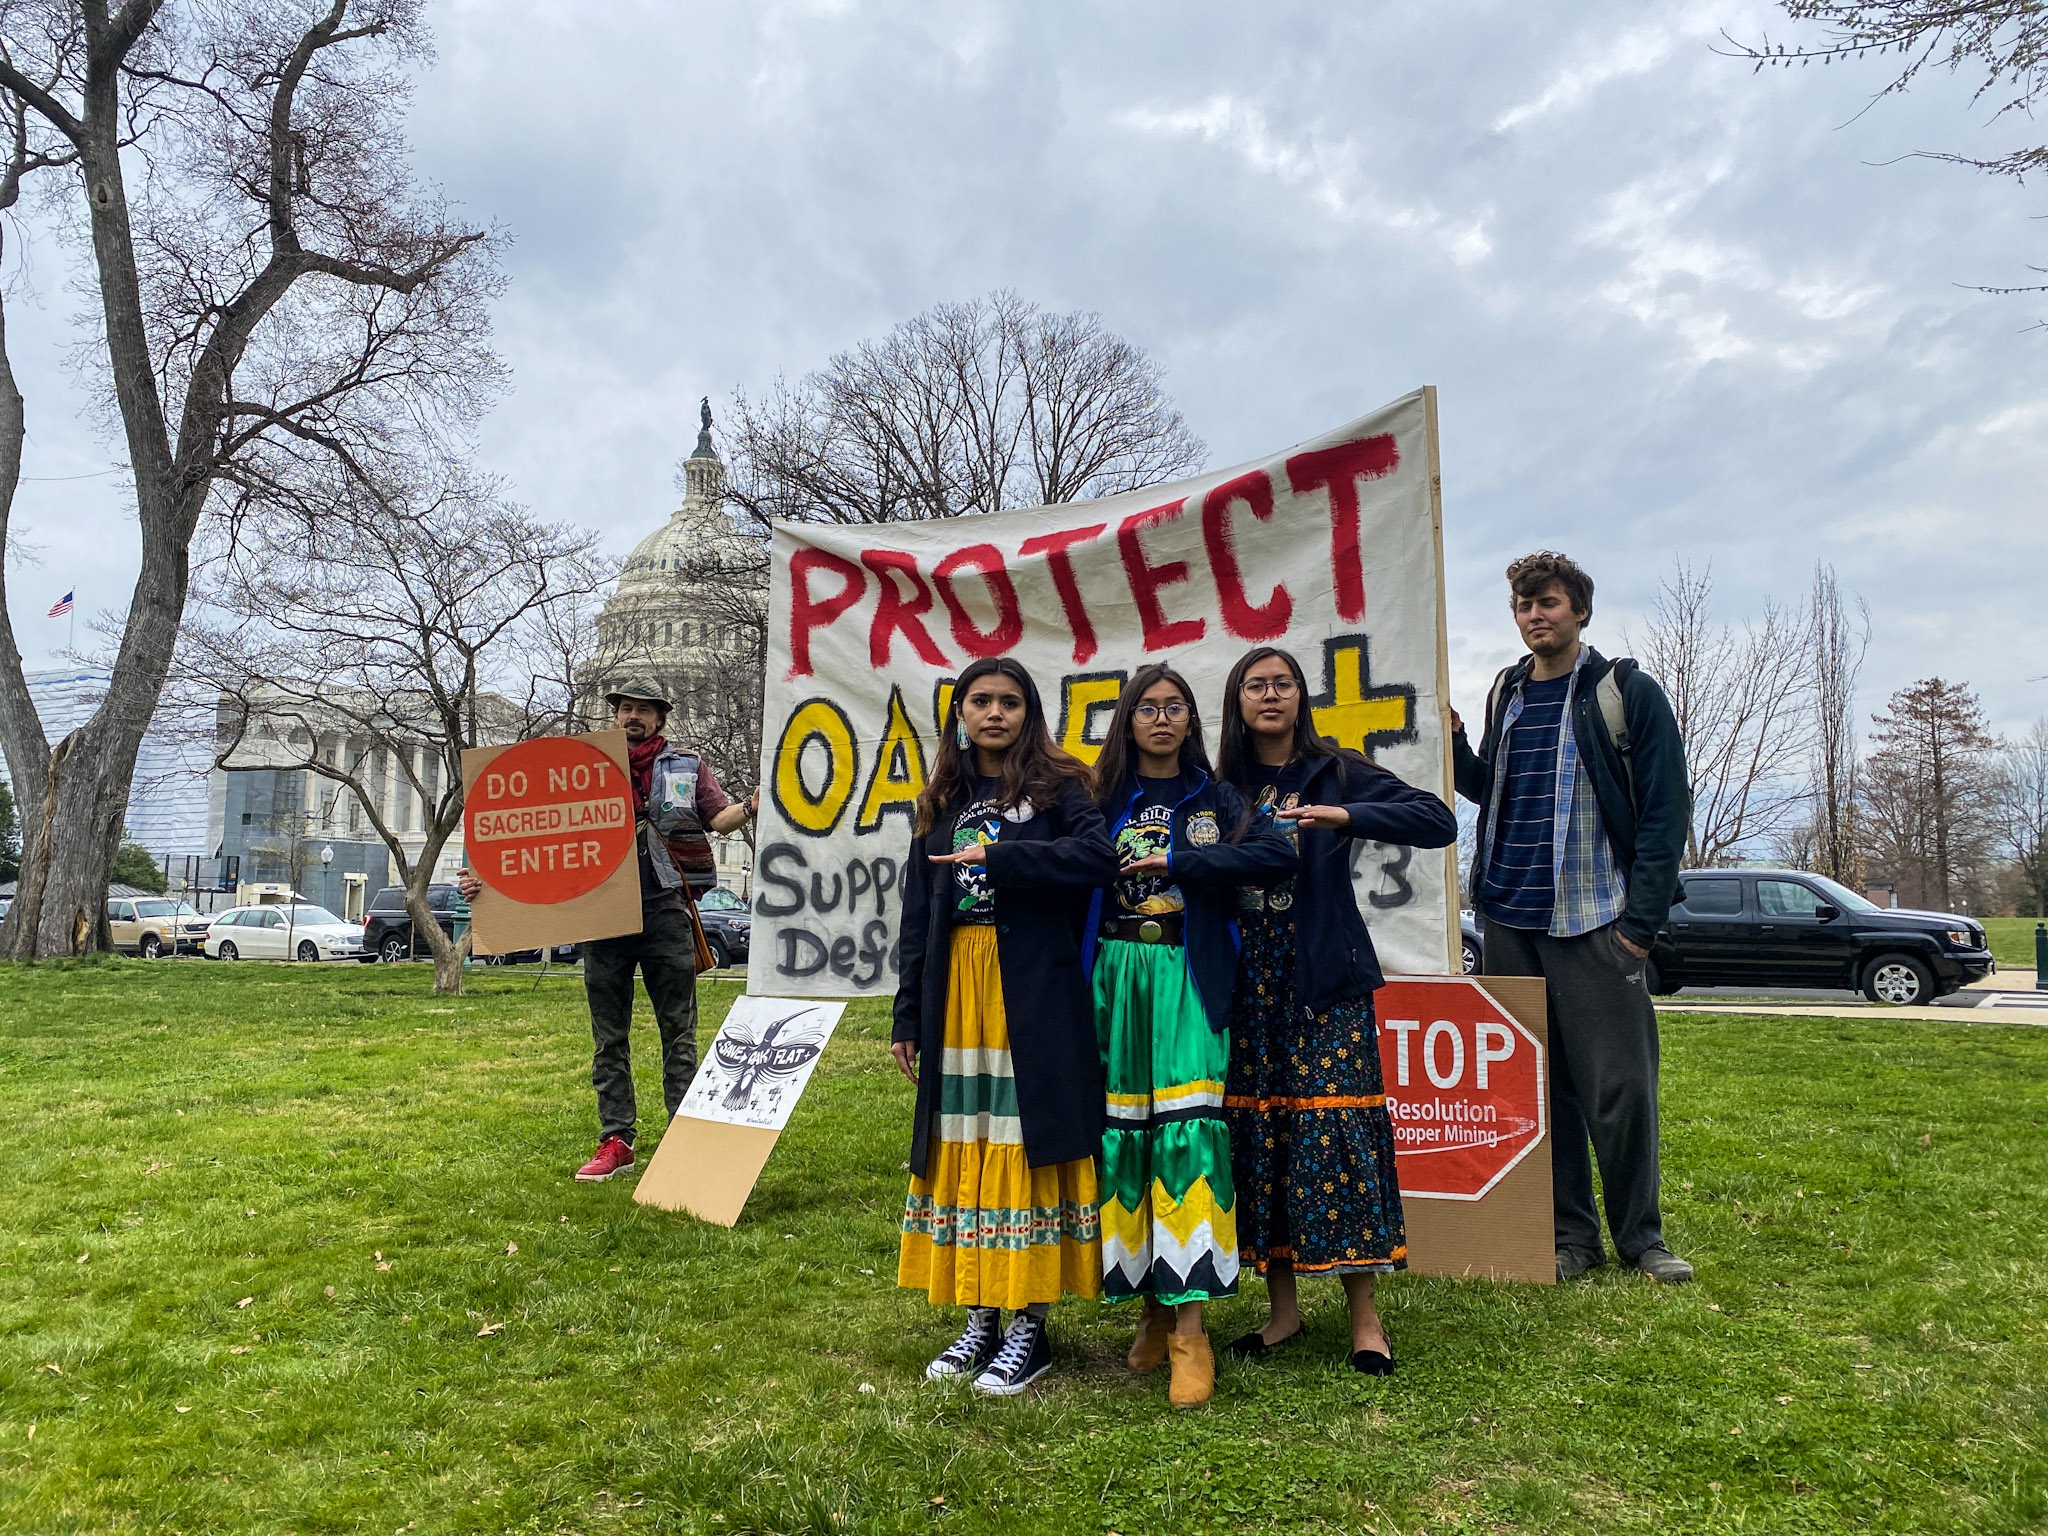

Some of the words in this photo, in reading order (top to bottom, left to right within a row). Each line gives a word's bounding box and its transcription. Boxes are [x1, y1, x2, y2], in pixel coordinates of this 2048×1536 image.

[785, 432, 1399, 682] PROTECT
[487, 771, 528, 800] DO
[548, 762, 610, 794] NOT
[479, 809, 561, 837] SACRED
[568, 802, 622, 827] LAND
[1140, 809, 1171, 821] BILD
[501, 841, 601, 876] ENTER
[756, 843, 909, 917] Supp
[720, 1041, 746, 1060] SAVE
[747, 1049, 770, 1065] OAK
[773, 1049, 805, 1065] FLAT
[1376, 1019, 1516, 1090] TOP
[1386, 1097, 1497, 1122] Resolution
[1445, 1124, 1497, 1148] Mining
